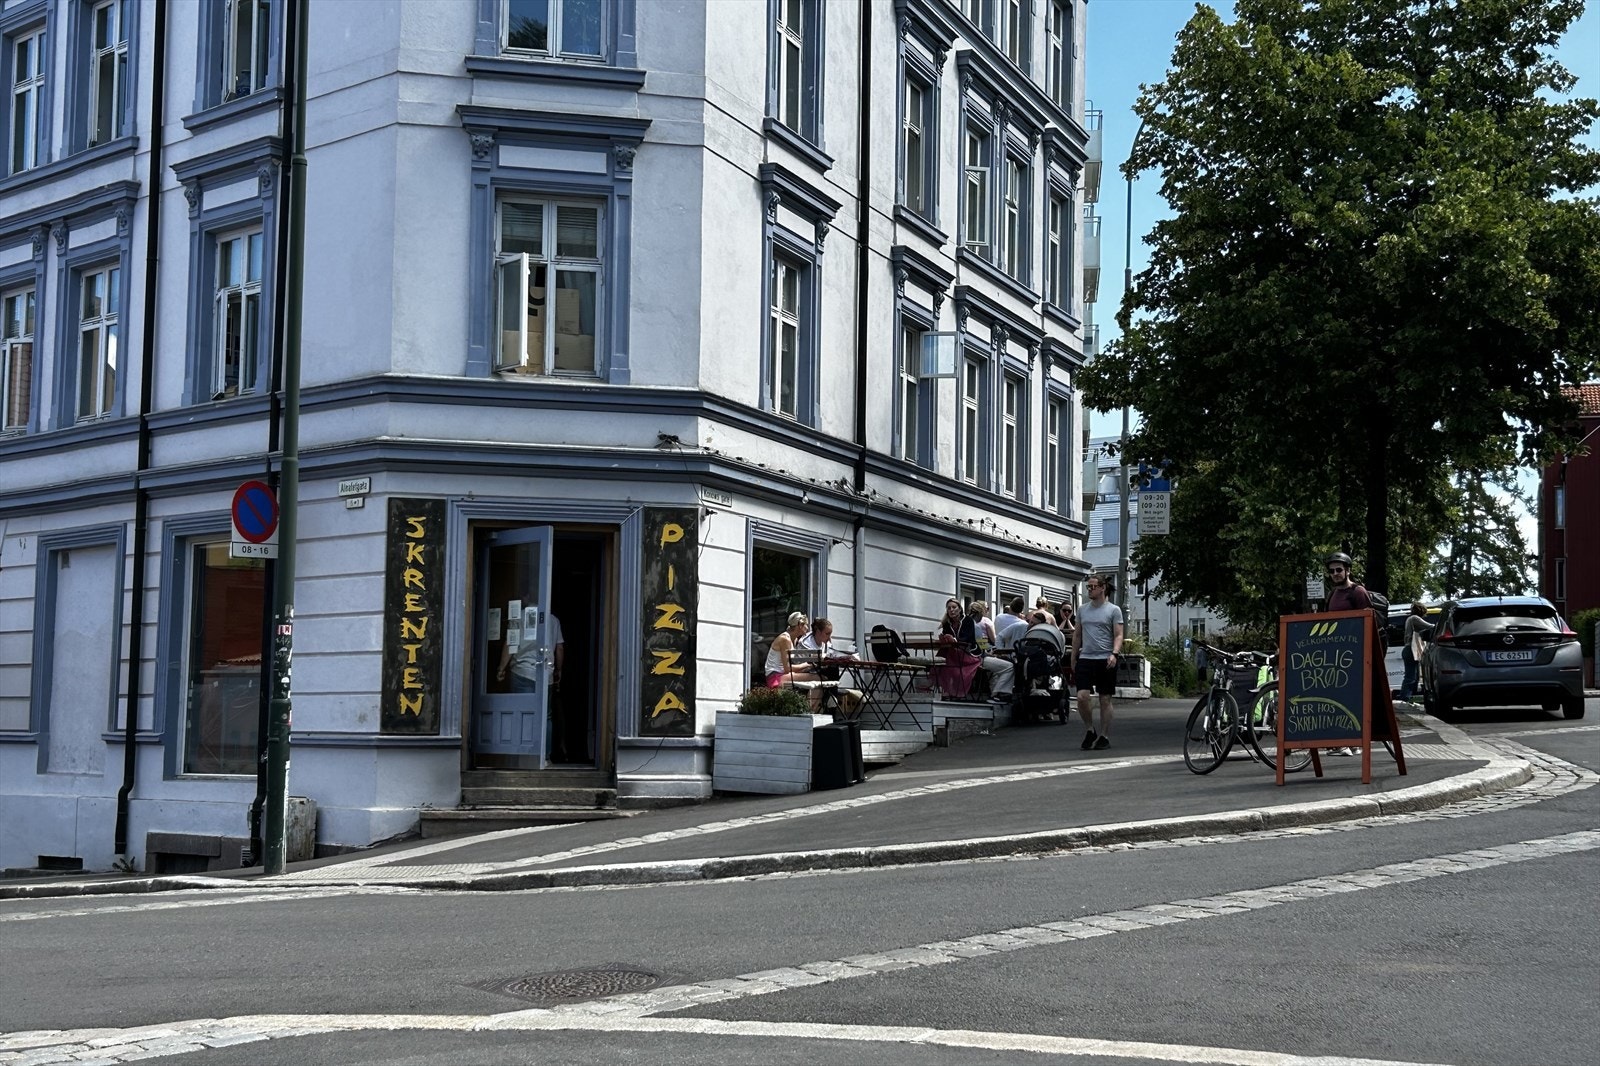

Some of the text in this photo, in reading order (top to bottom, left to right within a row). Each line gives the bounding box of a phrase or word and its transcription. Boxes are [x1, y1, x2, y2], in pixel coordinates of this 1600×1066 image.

[400, 516, 429, 716] SKRENTEN
[651, 523, 688, 718] PIZZA
[1295, 635, 1346, 649] VELKOMMEN
[1291, 649, 1353, 670] DAGLIG
[1495, 651, 1529, 660] EC 62511
[1301, 667, 1349, 691] BRØD
[1290, 703, 1336, 715] VI ER HOS
[1288, 715, 1333, 733] SKRENTEN
